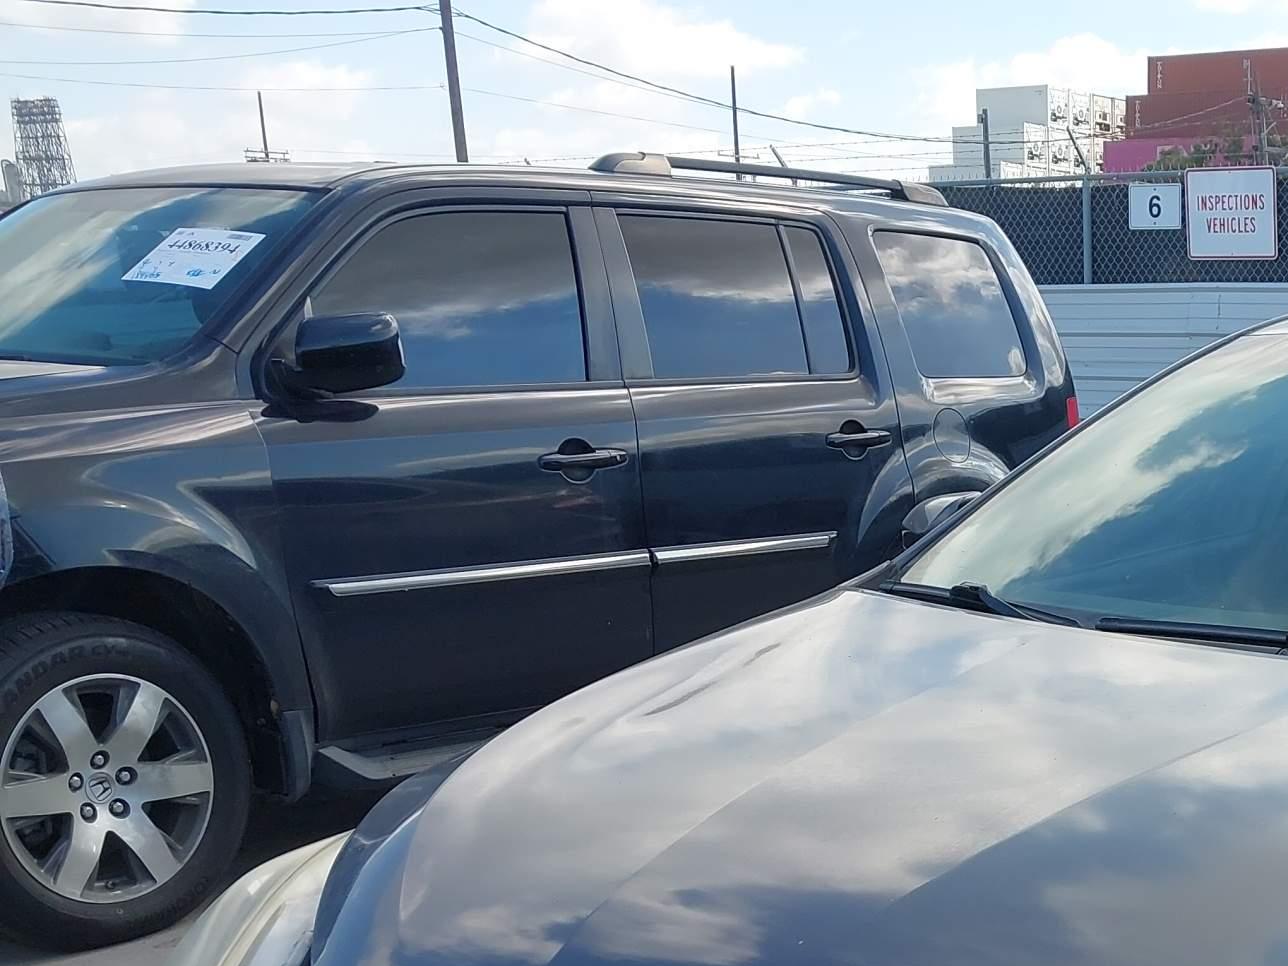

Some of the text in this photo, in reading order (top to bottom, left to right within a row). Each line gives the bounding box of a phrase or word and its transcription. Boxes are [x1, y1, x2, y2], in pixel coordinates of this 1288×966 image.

[1149, 195, 1162, 218] 6
[1197, 194, 1265, 211] INSPECTIONS
[1206, 217, 1256, 233] VEHICLES
[168, 240, 241, 254] 44868394
